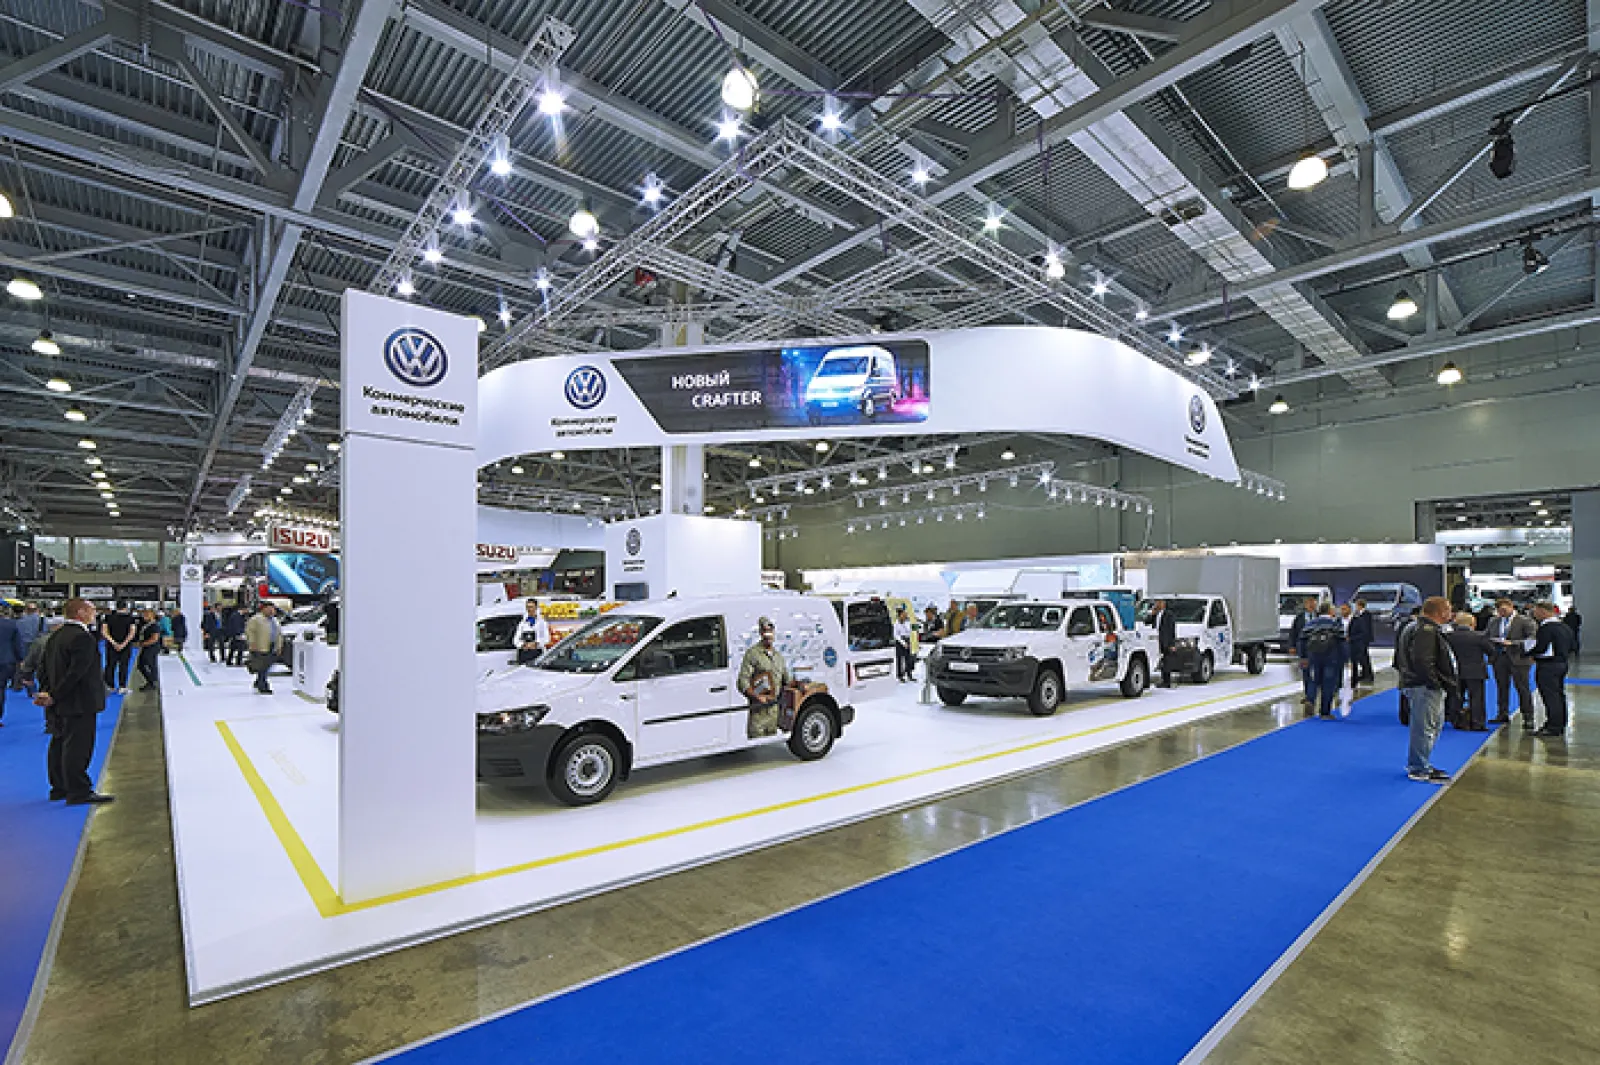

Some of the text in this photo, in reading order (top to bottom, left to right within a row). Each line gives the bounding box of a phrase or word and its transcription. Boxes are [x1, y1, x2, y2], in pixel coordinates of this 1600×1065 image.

[672, 370, 730, 389] НОВЫЙ
[363, 386, 465, 413] Коммерческие
[692, 391, 762, 408] CRAFTER
[371, 405, 459, 425] автомобили
[273, 527, 330, 548] ISUZU
[476, 543, 515, 560] SUZU
